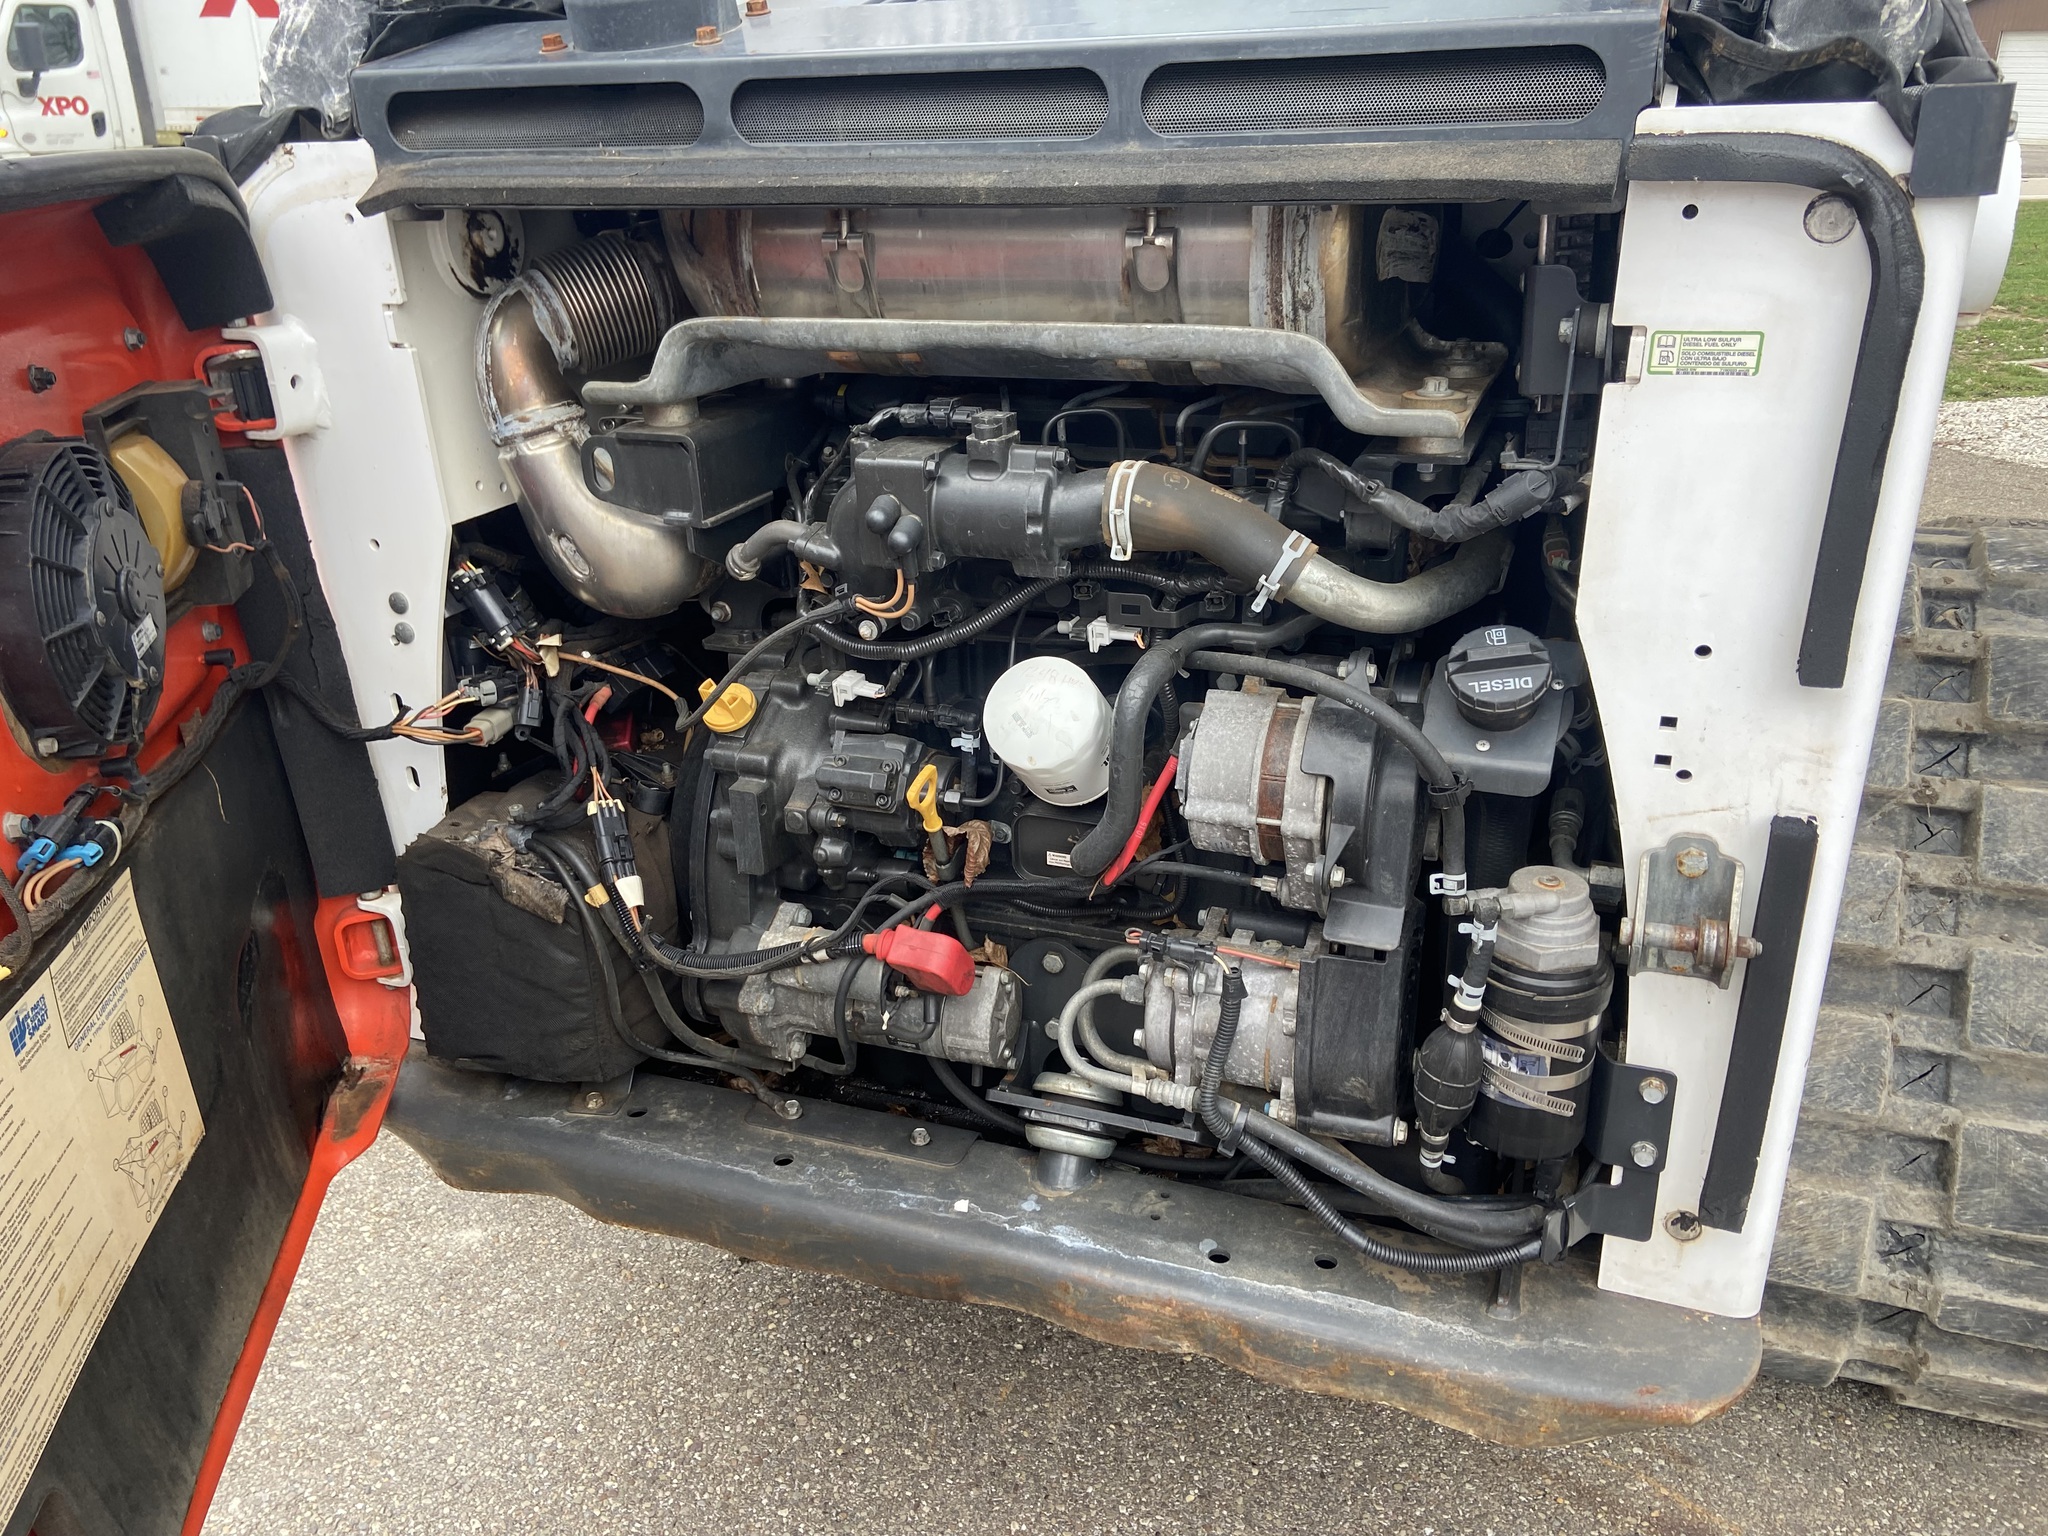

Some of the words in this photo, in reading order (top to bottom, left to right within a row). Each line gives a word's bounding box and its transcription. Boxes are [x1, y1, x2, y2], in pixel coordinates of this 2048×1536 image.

[38, 96, 89, 116] XPO
[1468, 677, 1533, 693] DIESEL
[81, 888, 114, 936] IMPORTANT
[74, 1018, 96, 1051] GENERAL
[95, 978, 126, 1020] LUBRICATION
[125, 947, 148, 981] DIAGRAMS
[28, 1009, 48, 1040] SMART
[4, 1478, 27, 1520] OPERATION
[28, 1421, 53, 1470] MAINTENANCE
[52, 1394, 67, 1420] MANUAL
[65, 1377, 74, 1393] FOR
[72, 1359, 83, 1378] MORE
[82, 1319, 104, 1359] INFORMATION
